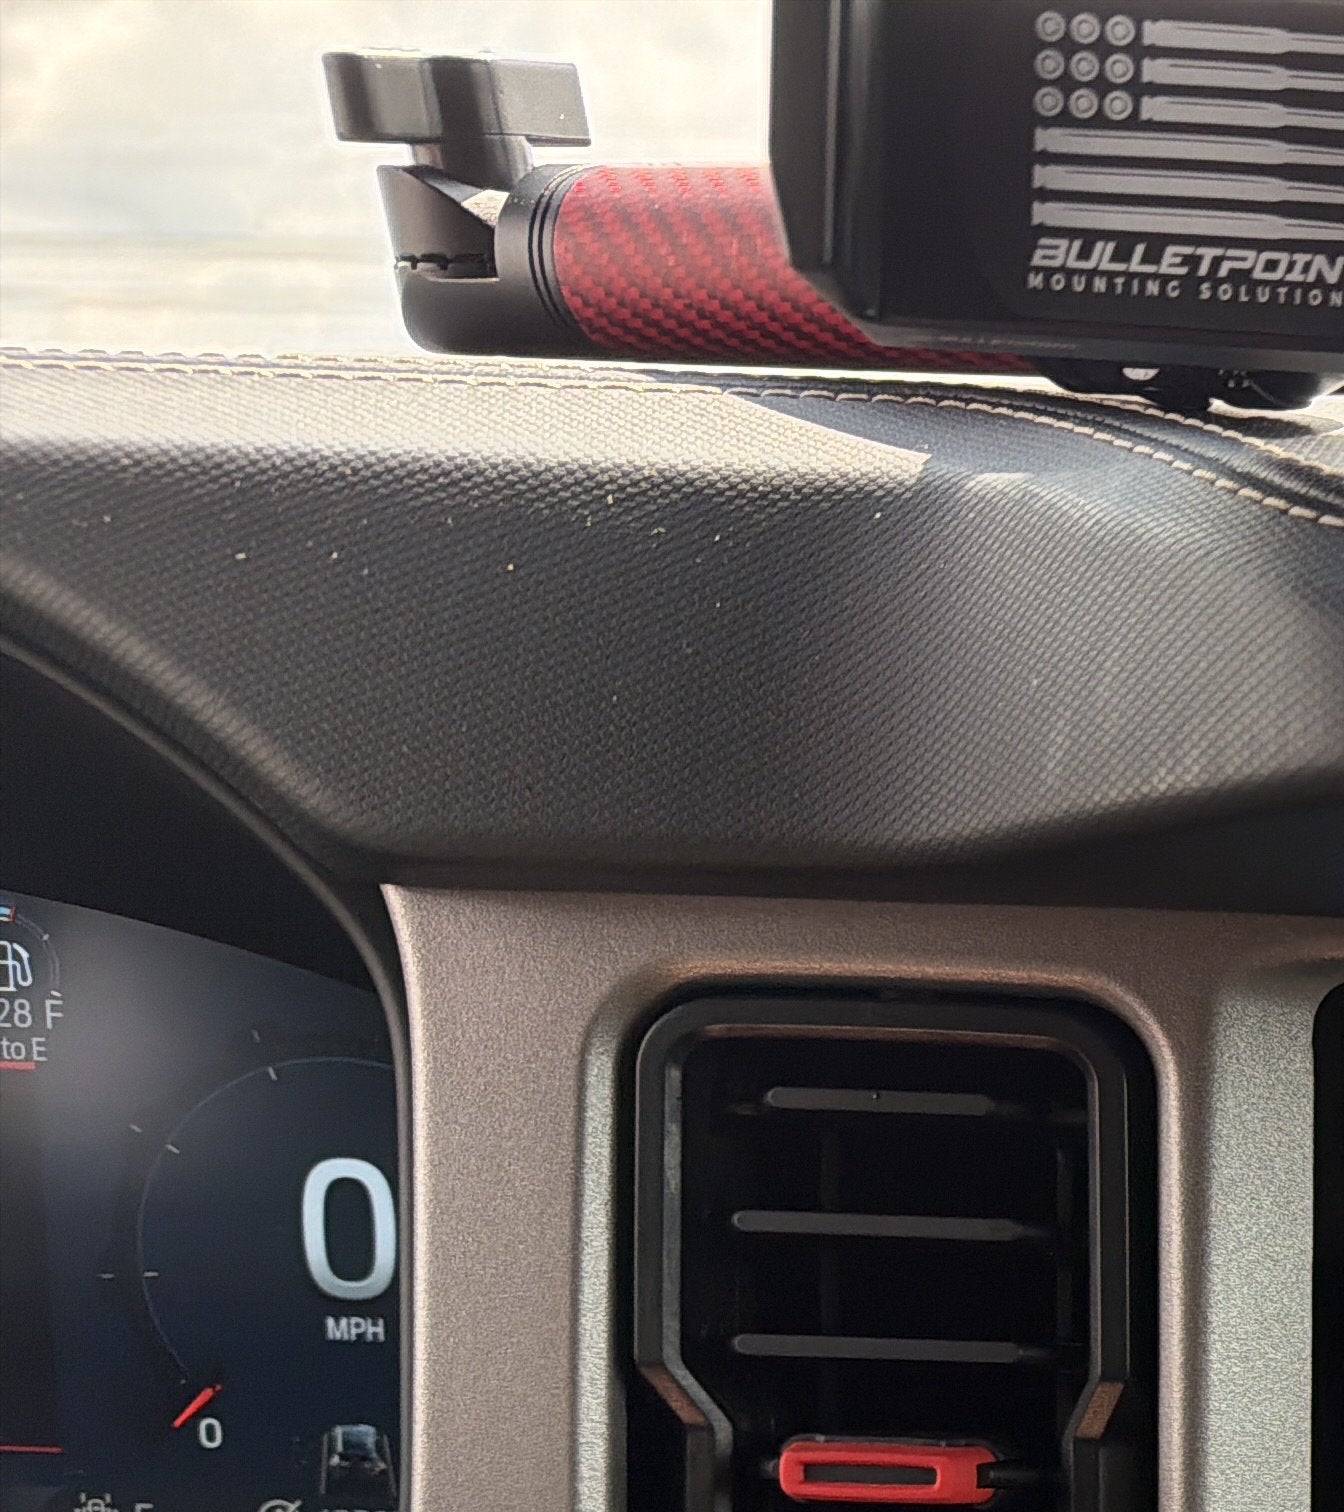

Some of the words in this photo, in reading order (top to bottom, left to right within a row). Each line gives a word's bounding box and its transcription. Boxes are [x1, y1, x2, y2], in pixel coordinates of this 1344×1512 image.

[1026, 271, 1183, 299] MOUNTING
[45, 999, 64, 1030] F
[2, 1037, 26, 1061] to
[32, 1037, 48, 1062] E
[302, 1157, 396, 1300] 0
[326, 1317, 385, 1343] MPH
[199, 1418, 223, 1449] 0
